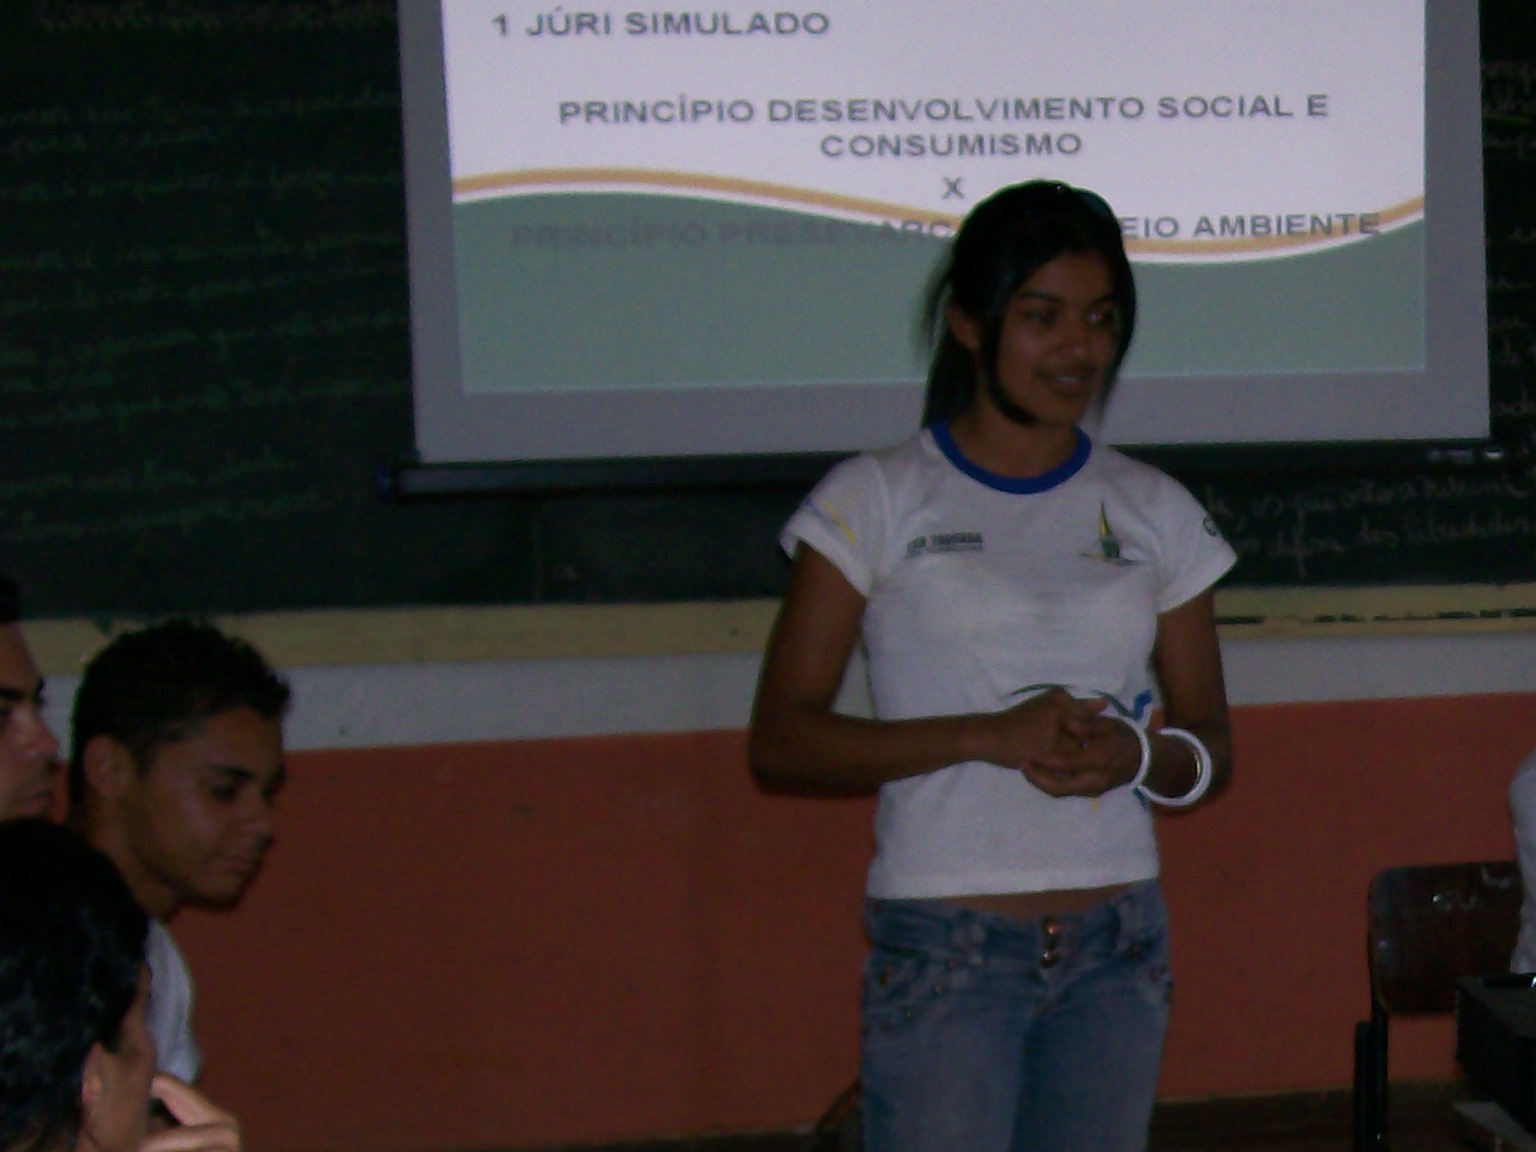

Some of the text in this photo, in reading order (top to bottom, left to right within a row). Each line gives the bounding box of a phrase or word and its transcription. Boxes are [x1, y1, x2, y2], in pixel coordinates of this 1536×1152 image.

[491, 5, 830, 36] 1 JÚRI SIMULADO
[559, 93, 1329, 124] PRINCÍPIO DESENVOLVIMENTO SOCIAL E
[820, 133, 1083, 157] CONSUMISMO
[942, 176, 965, 200] X
[1120, 215, 1180, 240] EIO
[1193, 213, 1383, 238] AMBIENTE
